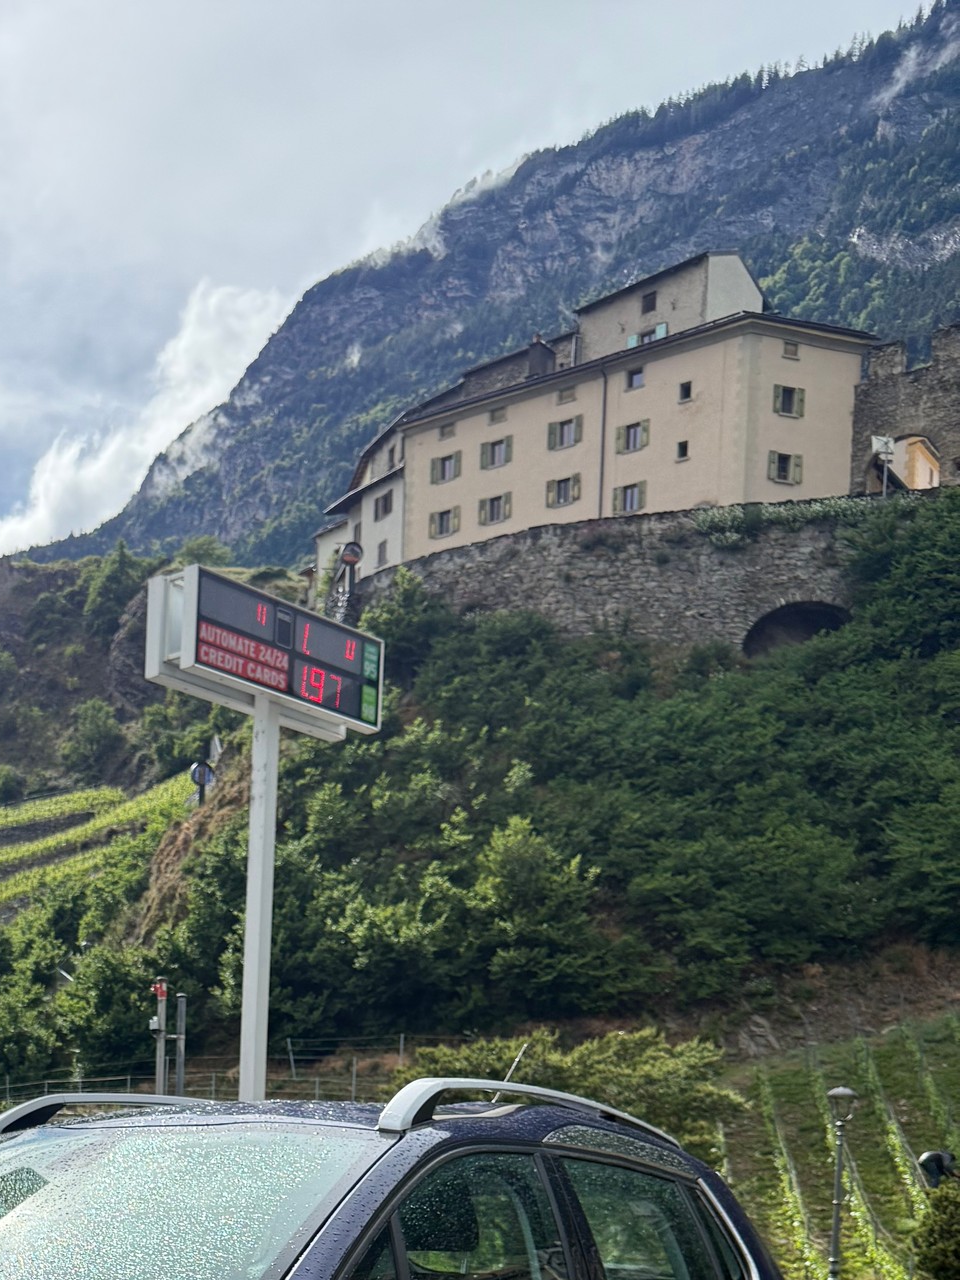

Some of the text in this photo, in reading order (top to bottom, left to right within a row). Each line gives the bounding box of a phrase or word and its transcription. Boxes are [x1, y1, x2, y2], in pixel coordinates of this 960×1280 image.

[200, 623, 289, 672] AUTOMATE 24/24
[200, 644, 286, 689] CREDIT CARDS
[363, 660, 378, 681] 95
